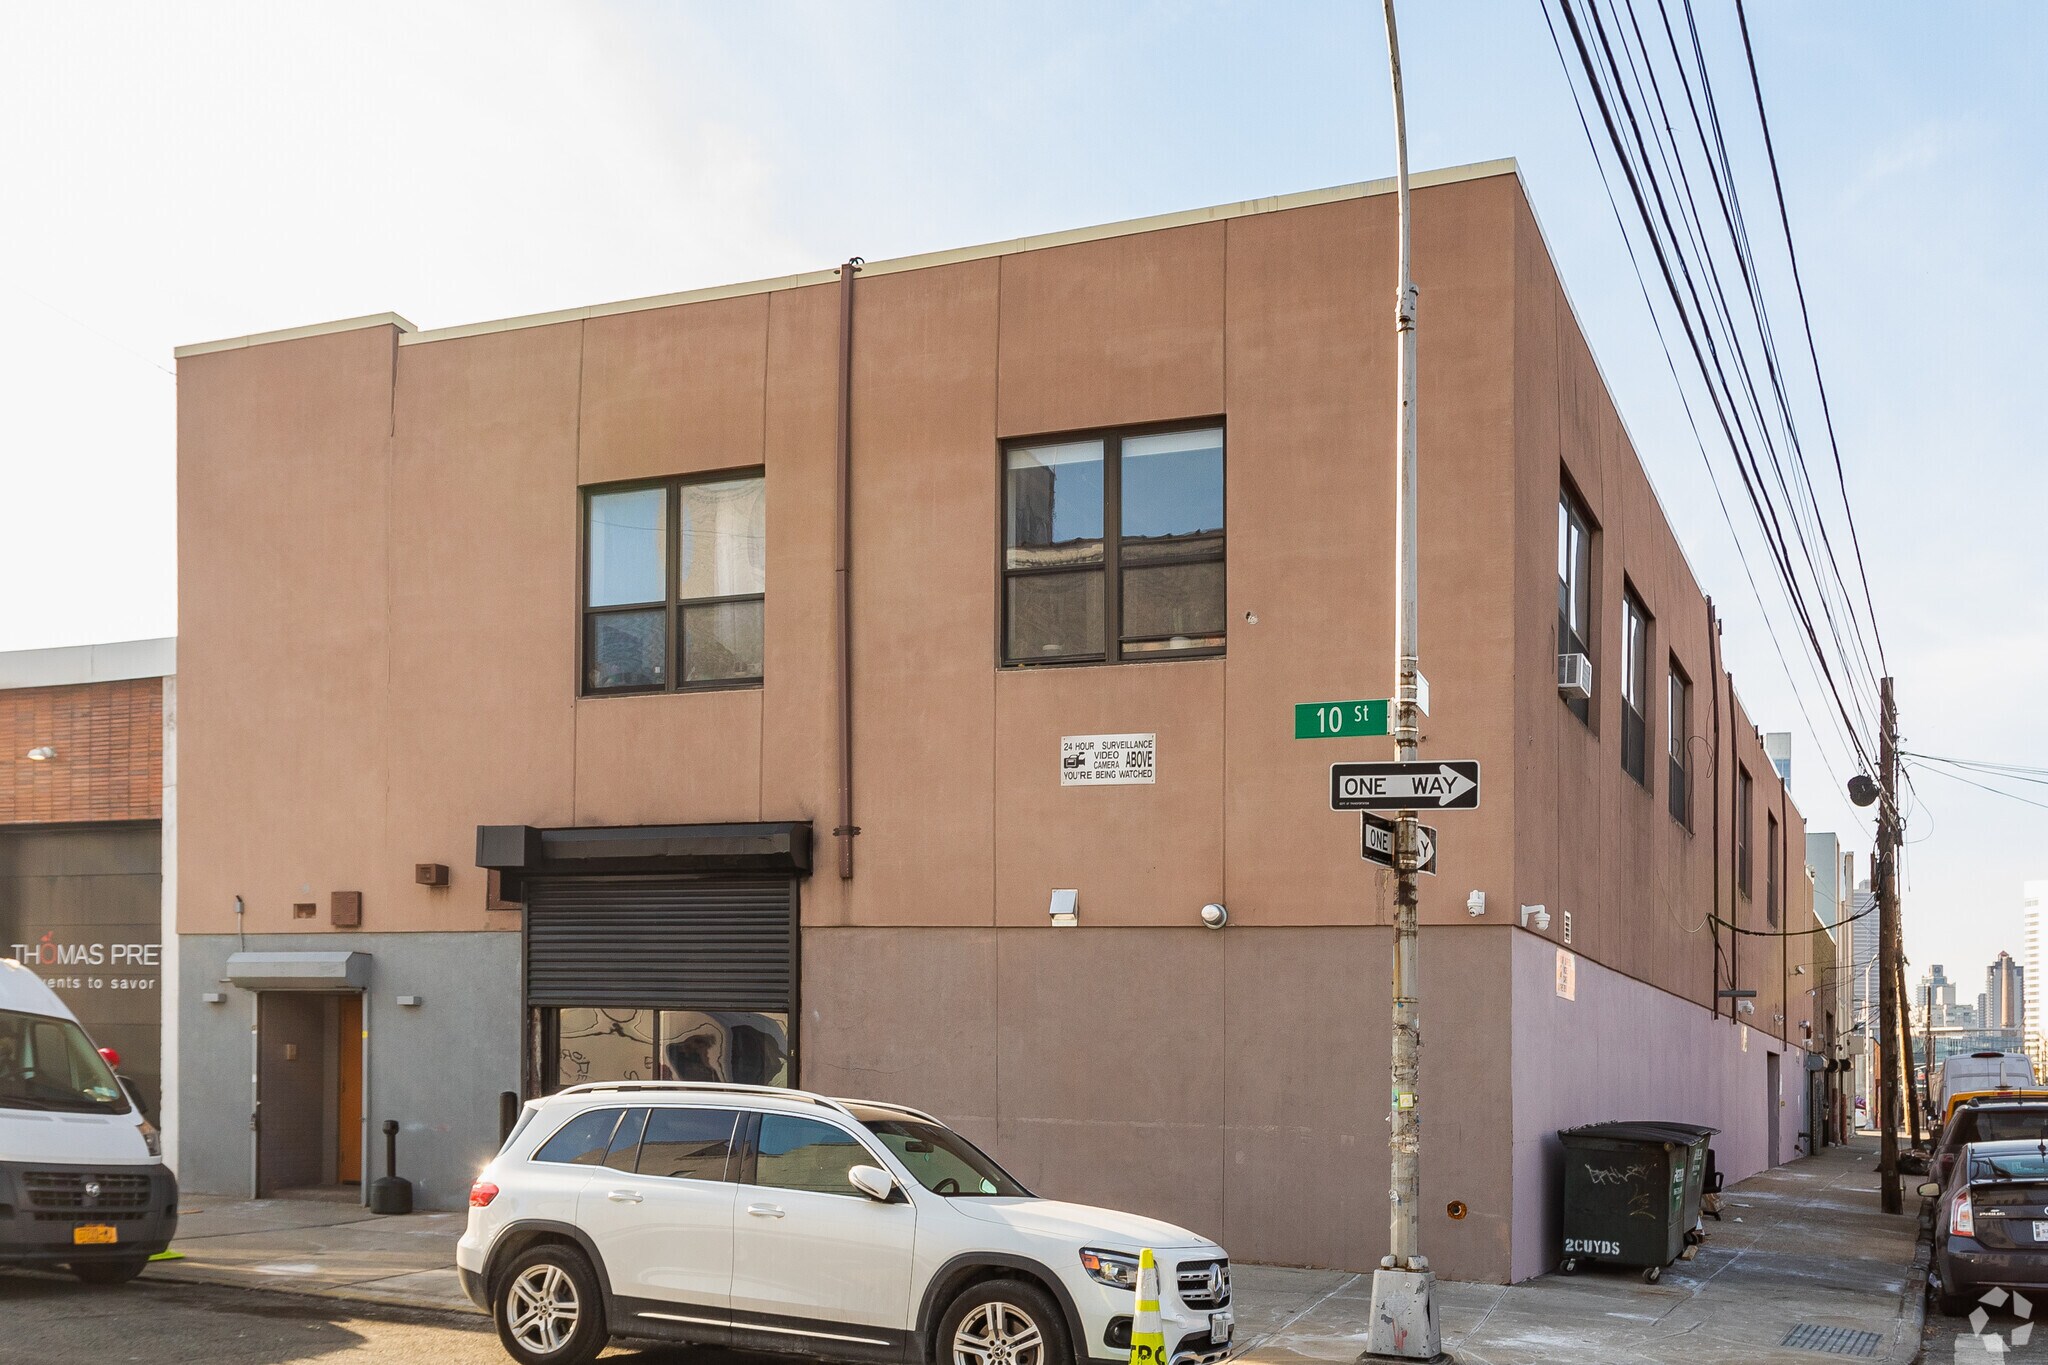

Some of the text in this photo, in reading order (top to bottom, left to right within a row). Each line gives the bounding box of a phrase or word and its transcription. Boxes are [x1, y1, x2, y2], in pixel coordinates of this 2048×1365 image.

[1316, 704, 1369, 733] 10 St
[1064, 740, 1153, 751] 24 HOUR SURVEILLANCE
[1094, 750, 1120, 760] VIDEO
[1125, 750, 1153, 768] ABOVE
[1093, 760, 1120, 770] CAMERA
[1063, 769, 1153, 780] YOU'RE BEING WATCHED
[1344, 776, 1459, 796] ONE WAY
[1370, 828, 1389, 851] ONE
[10, 943, 162, 966] THOMAS PRE
[88, 976, 104, 989] to
[110, 978, 156, 990] savor
